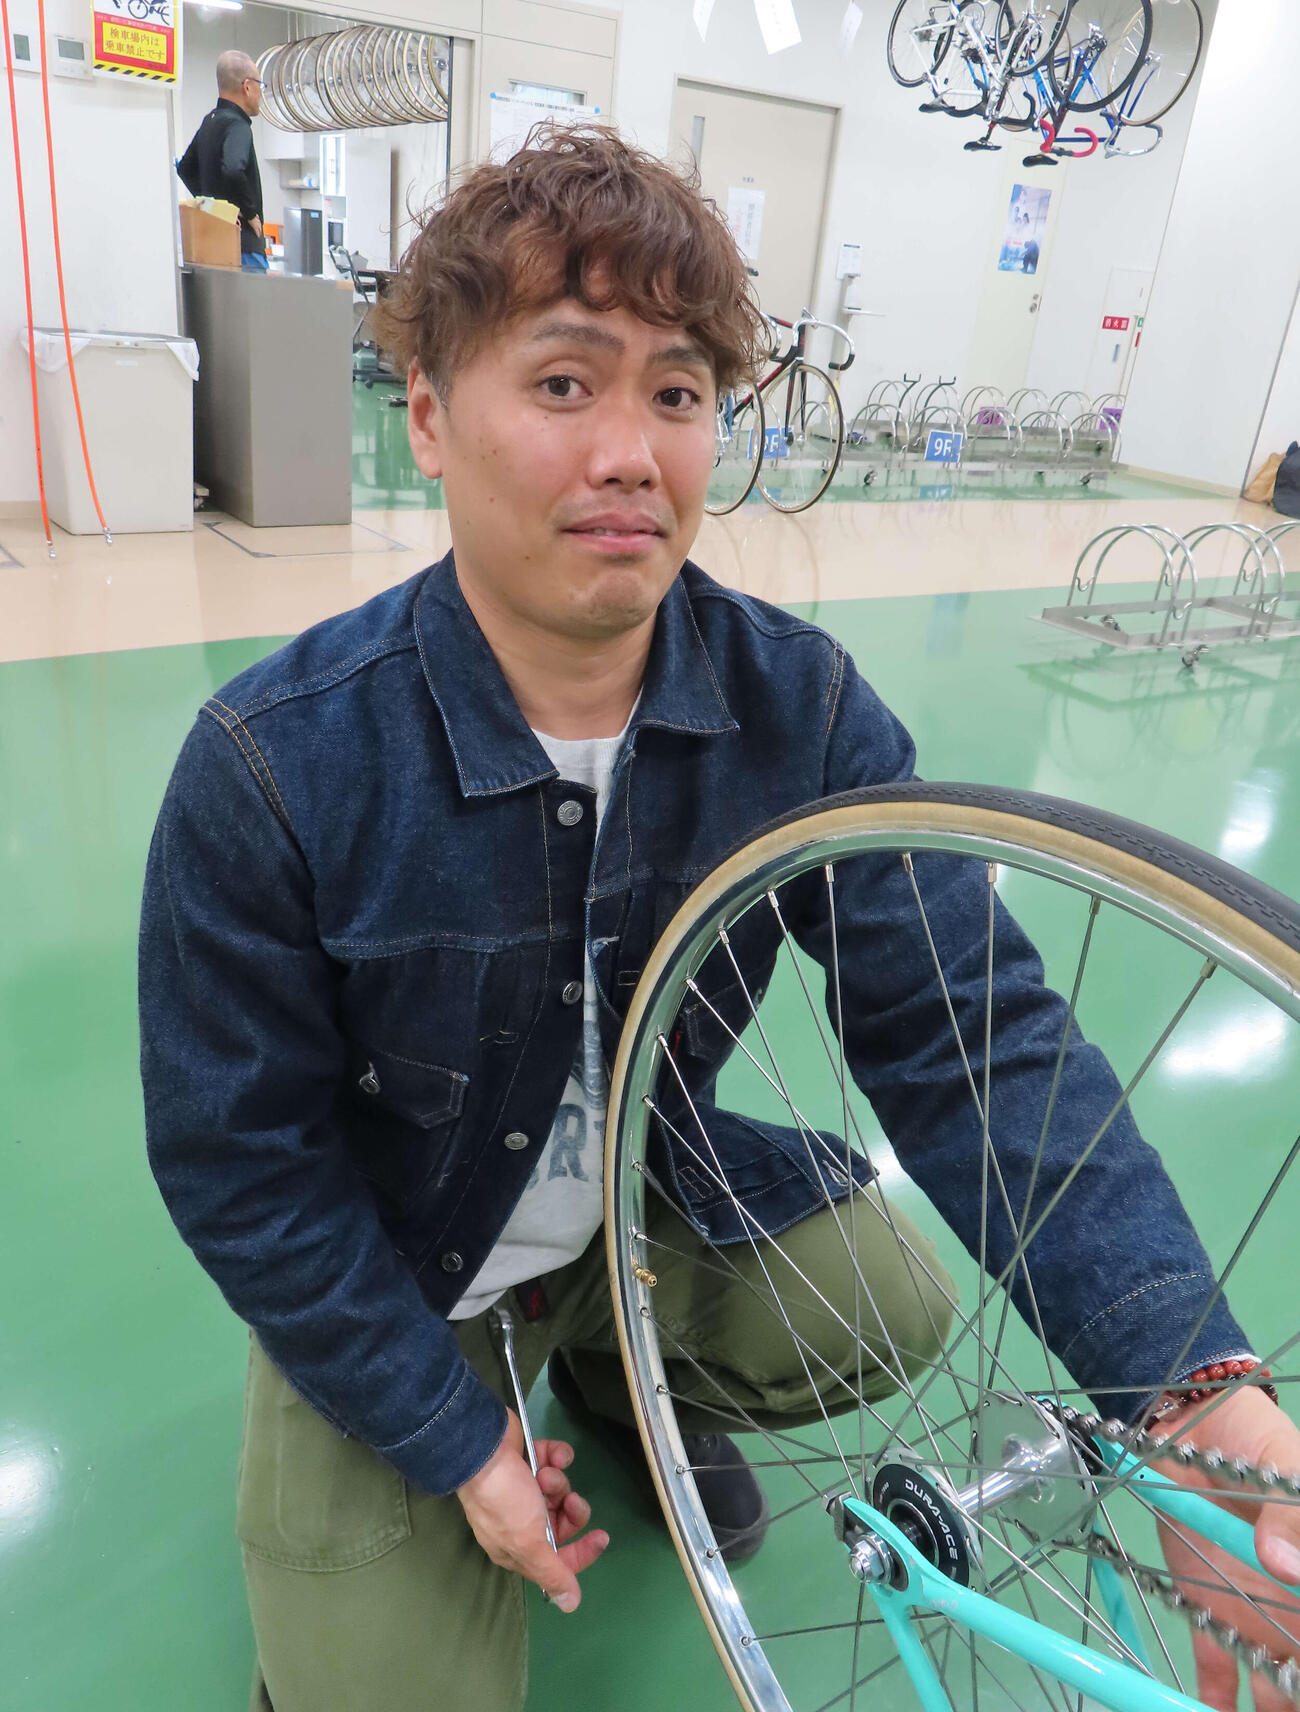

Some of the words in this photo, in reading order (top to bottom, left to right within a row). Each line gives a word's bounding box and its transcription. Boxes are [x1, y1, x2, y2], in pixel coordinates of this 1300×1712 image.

[110, 27, 159, 46] 検車場内は
[106, 40, 165, 60] 乗車禁止です
[904, 1478, 959, 1561] DURA-ACE
